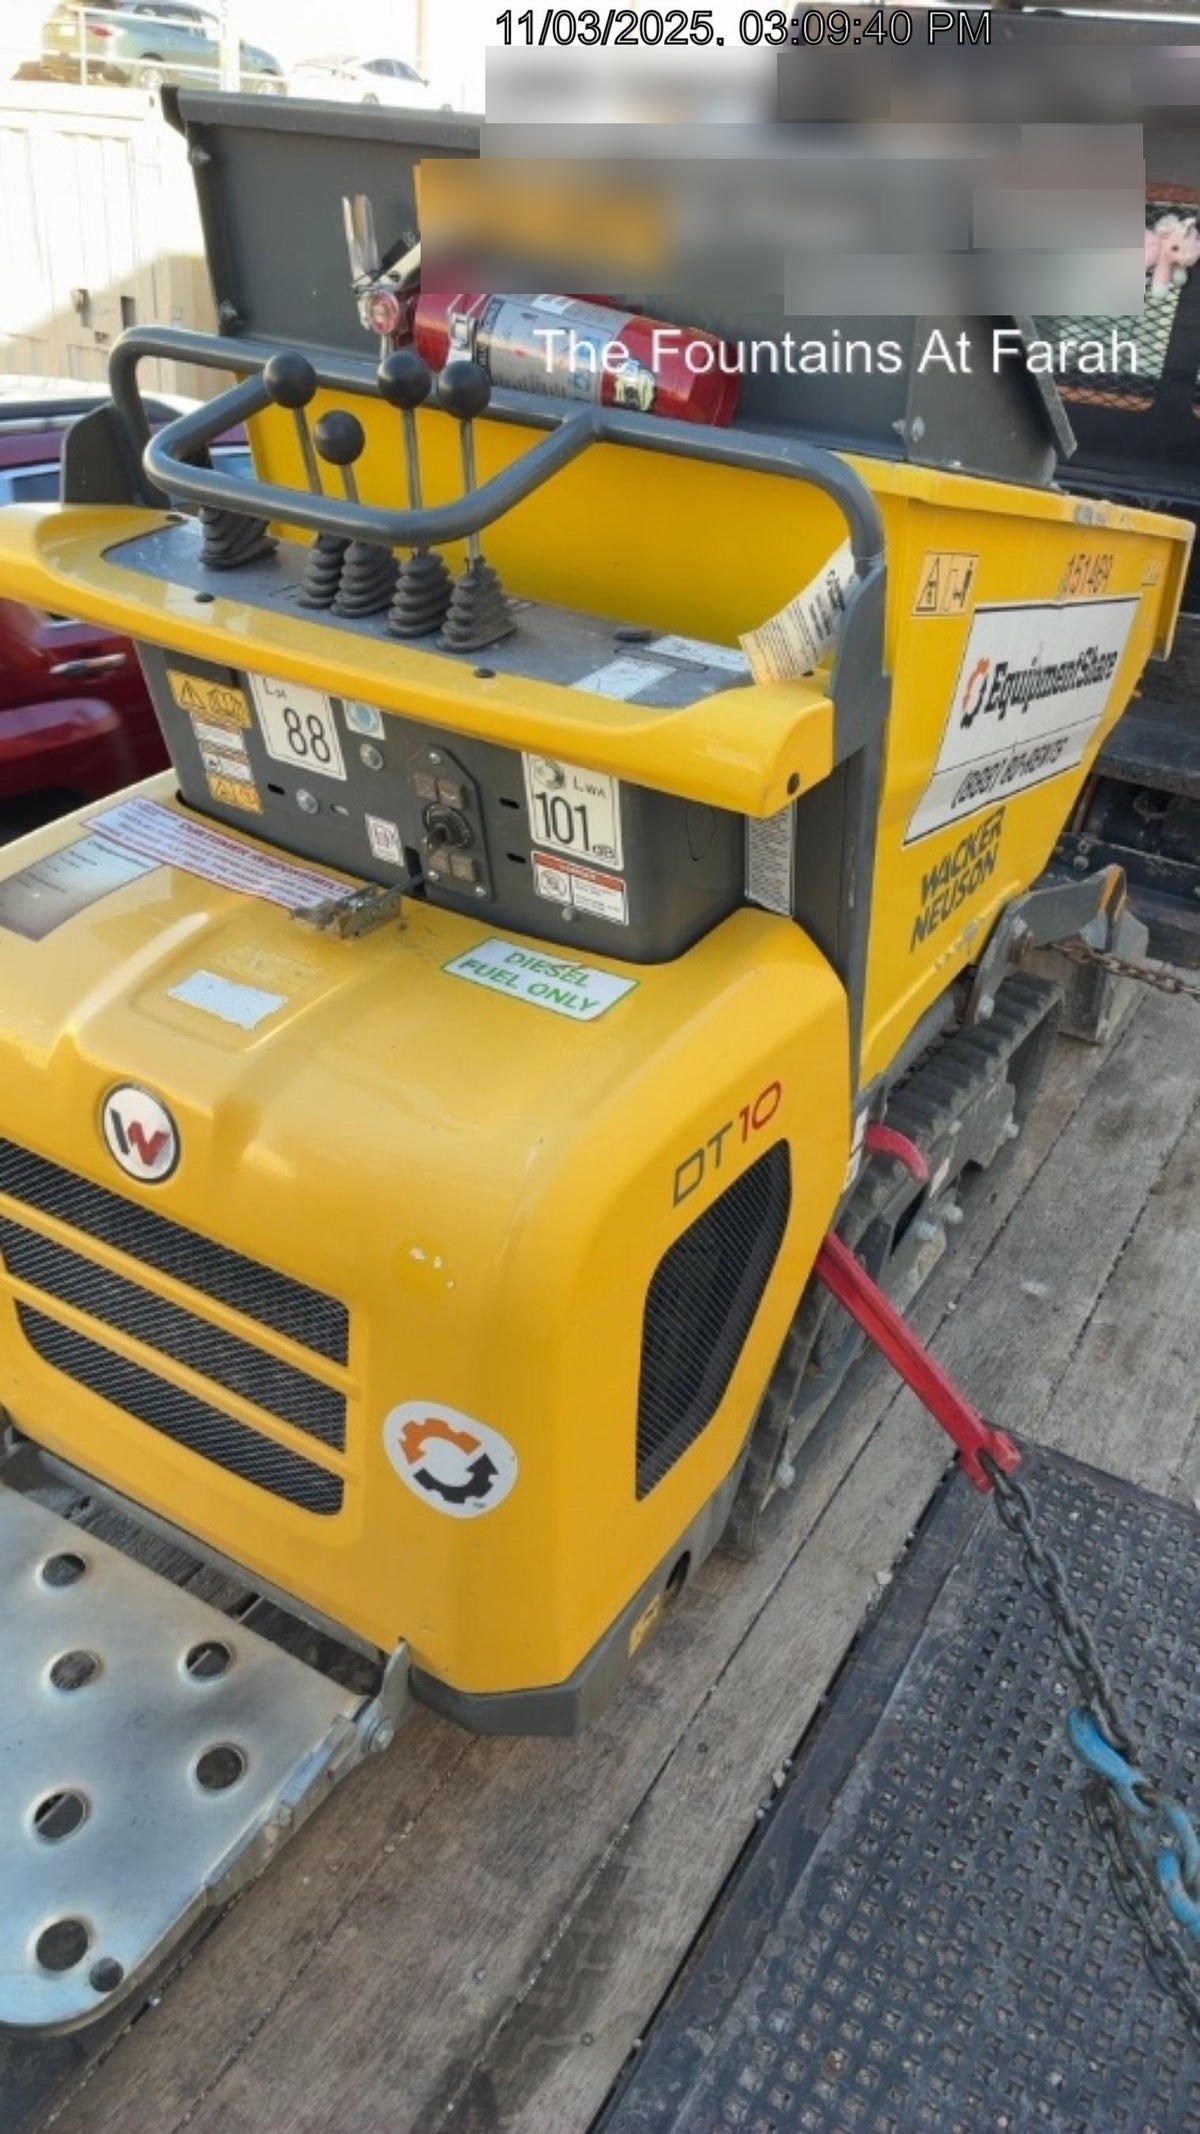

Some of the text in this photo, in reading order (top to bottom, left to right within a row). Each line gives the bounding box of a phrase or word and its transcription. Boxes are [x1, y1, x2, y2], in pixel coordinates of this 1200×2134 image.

[983, 645, 1119, 721] EquipmentShare
[283, 706, 331, 764] 88
[534, 791, 591, 852] 101
[921, 806, 1006, 906] WACKER
[910, 841, 999, 953] NEUSON
[457, 956, 600, 1013] FUEL ONLY
[504, 951, 593, 988] DIESEL
